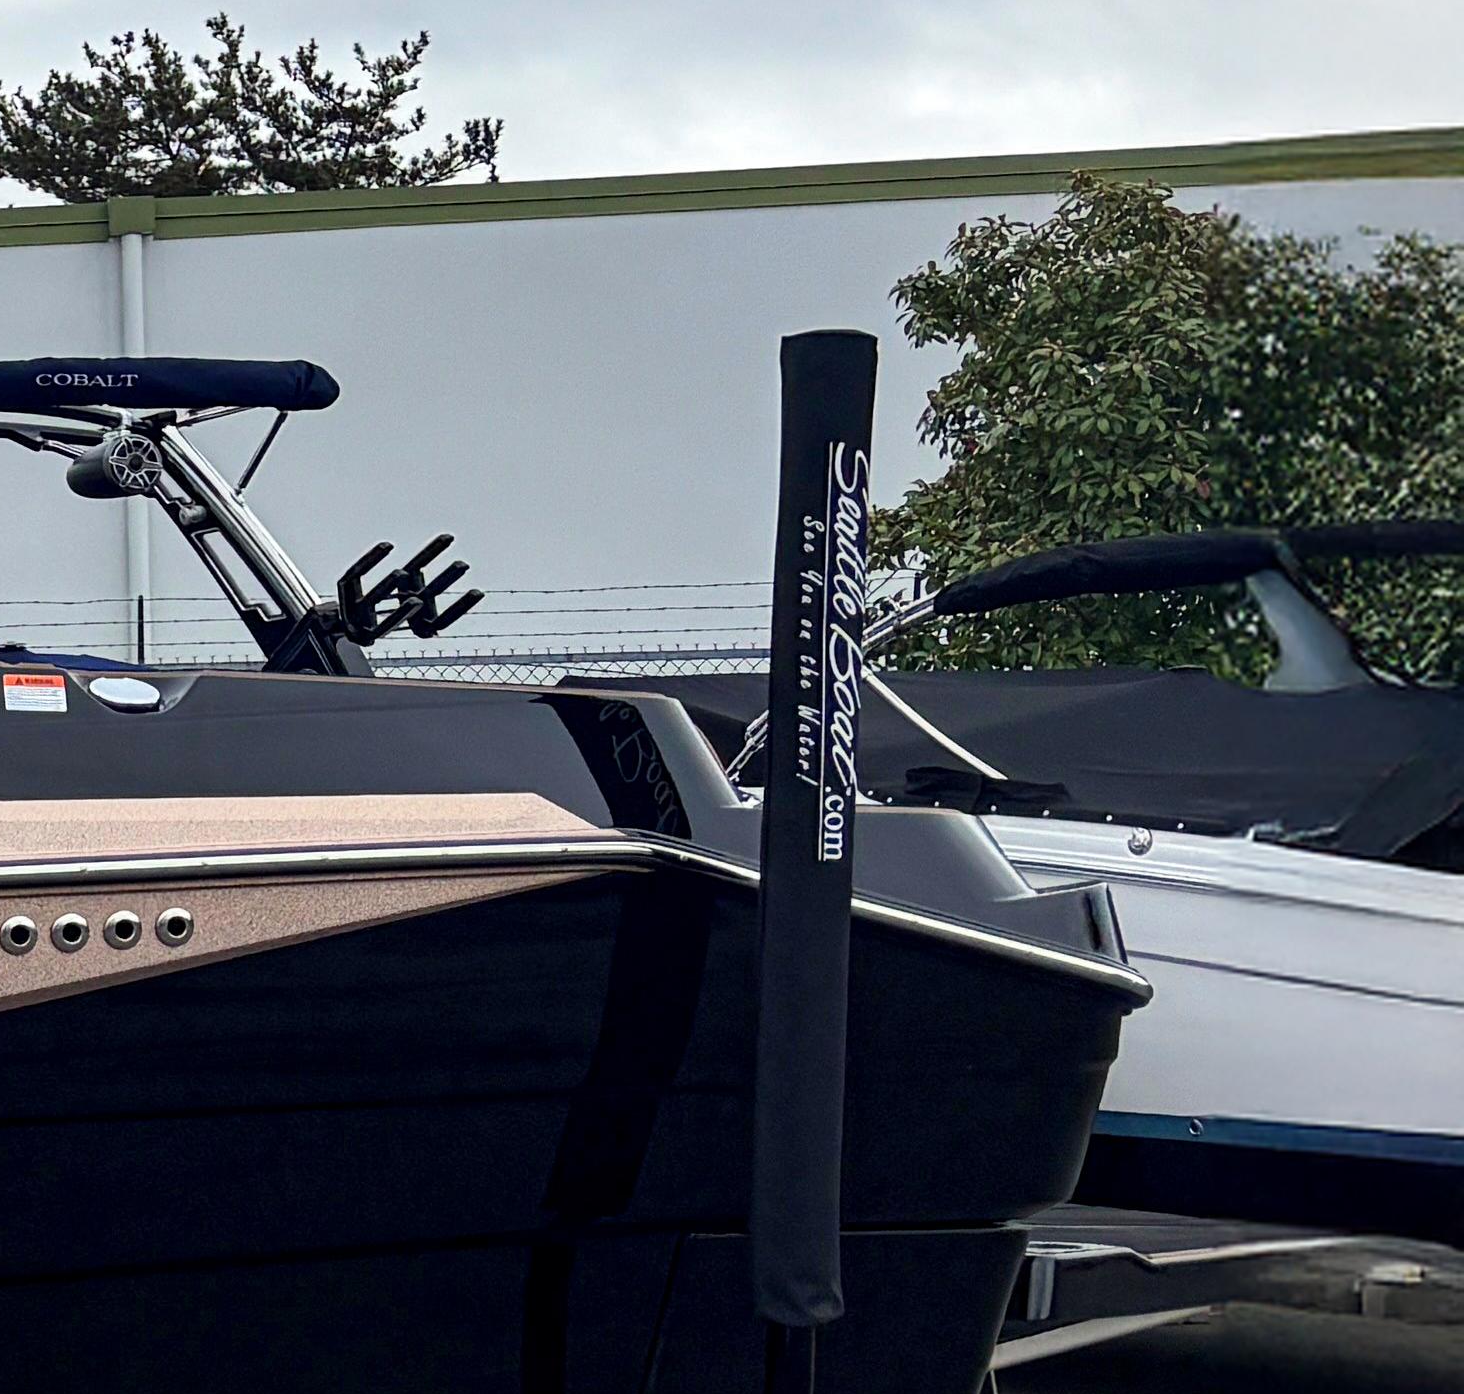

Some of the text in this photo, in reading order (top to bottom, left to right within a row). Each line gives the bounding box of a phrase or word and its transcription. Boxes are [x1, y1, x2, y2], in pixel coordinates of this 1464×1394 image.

[35, 373, 139, 388] COBALT
[802, 515, 826, 554] See
[833, 442, 869, 618] Seattle
[800, 569, 824, 605] You
[798, 654, 819, 691] the
